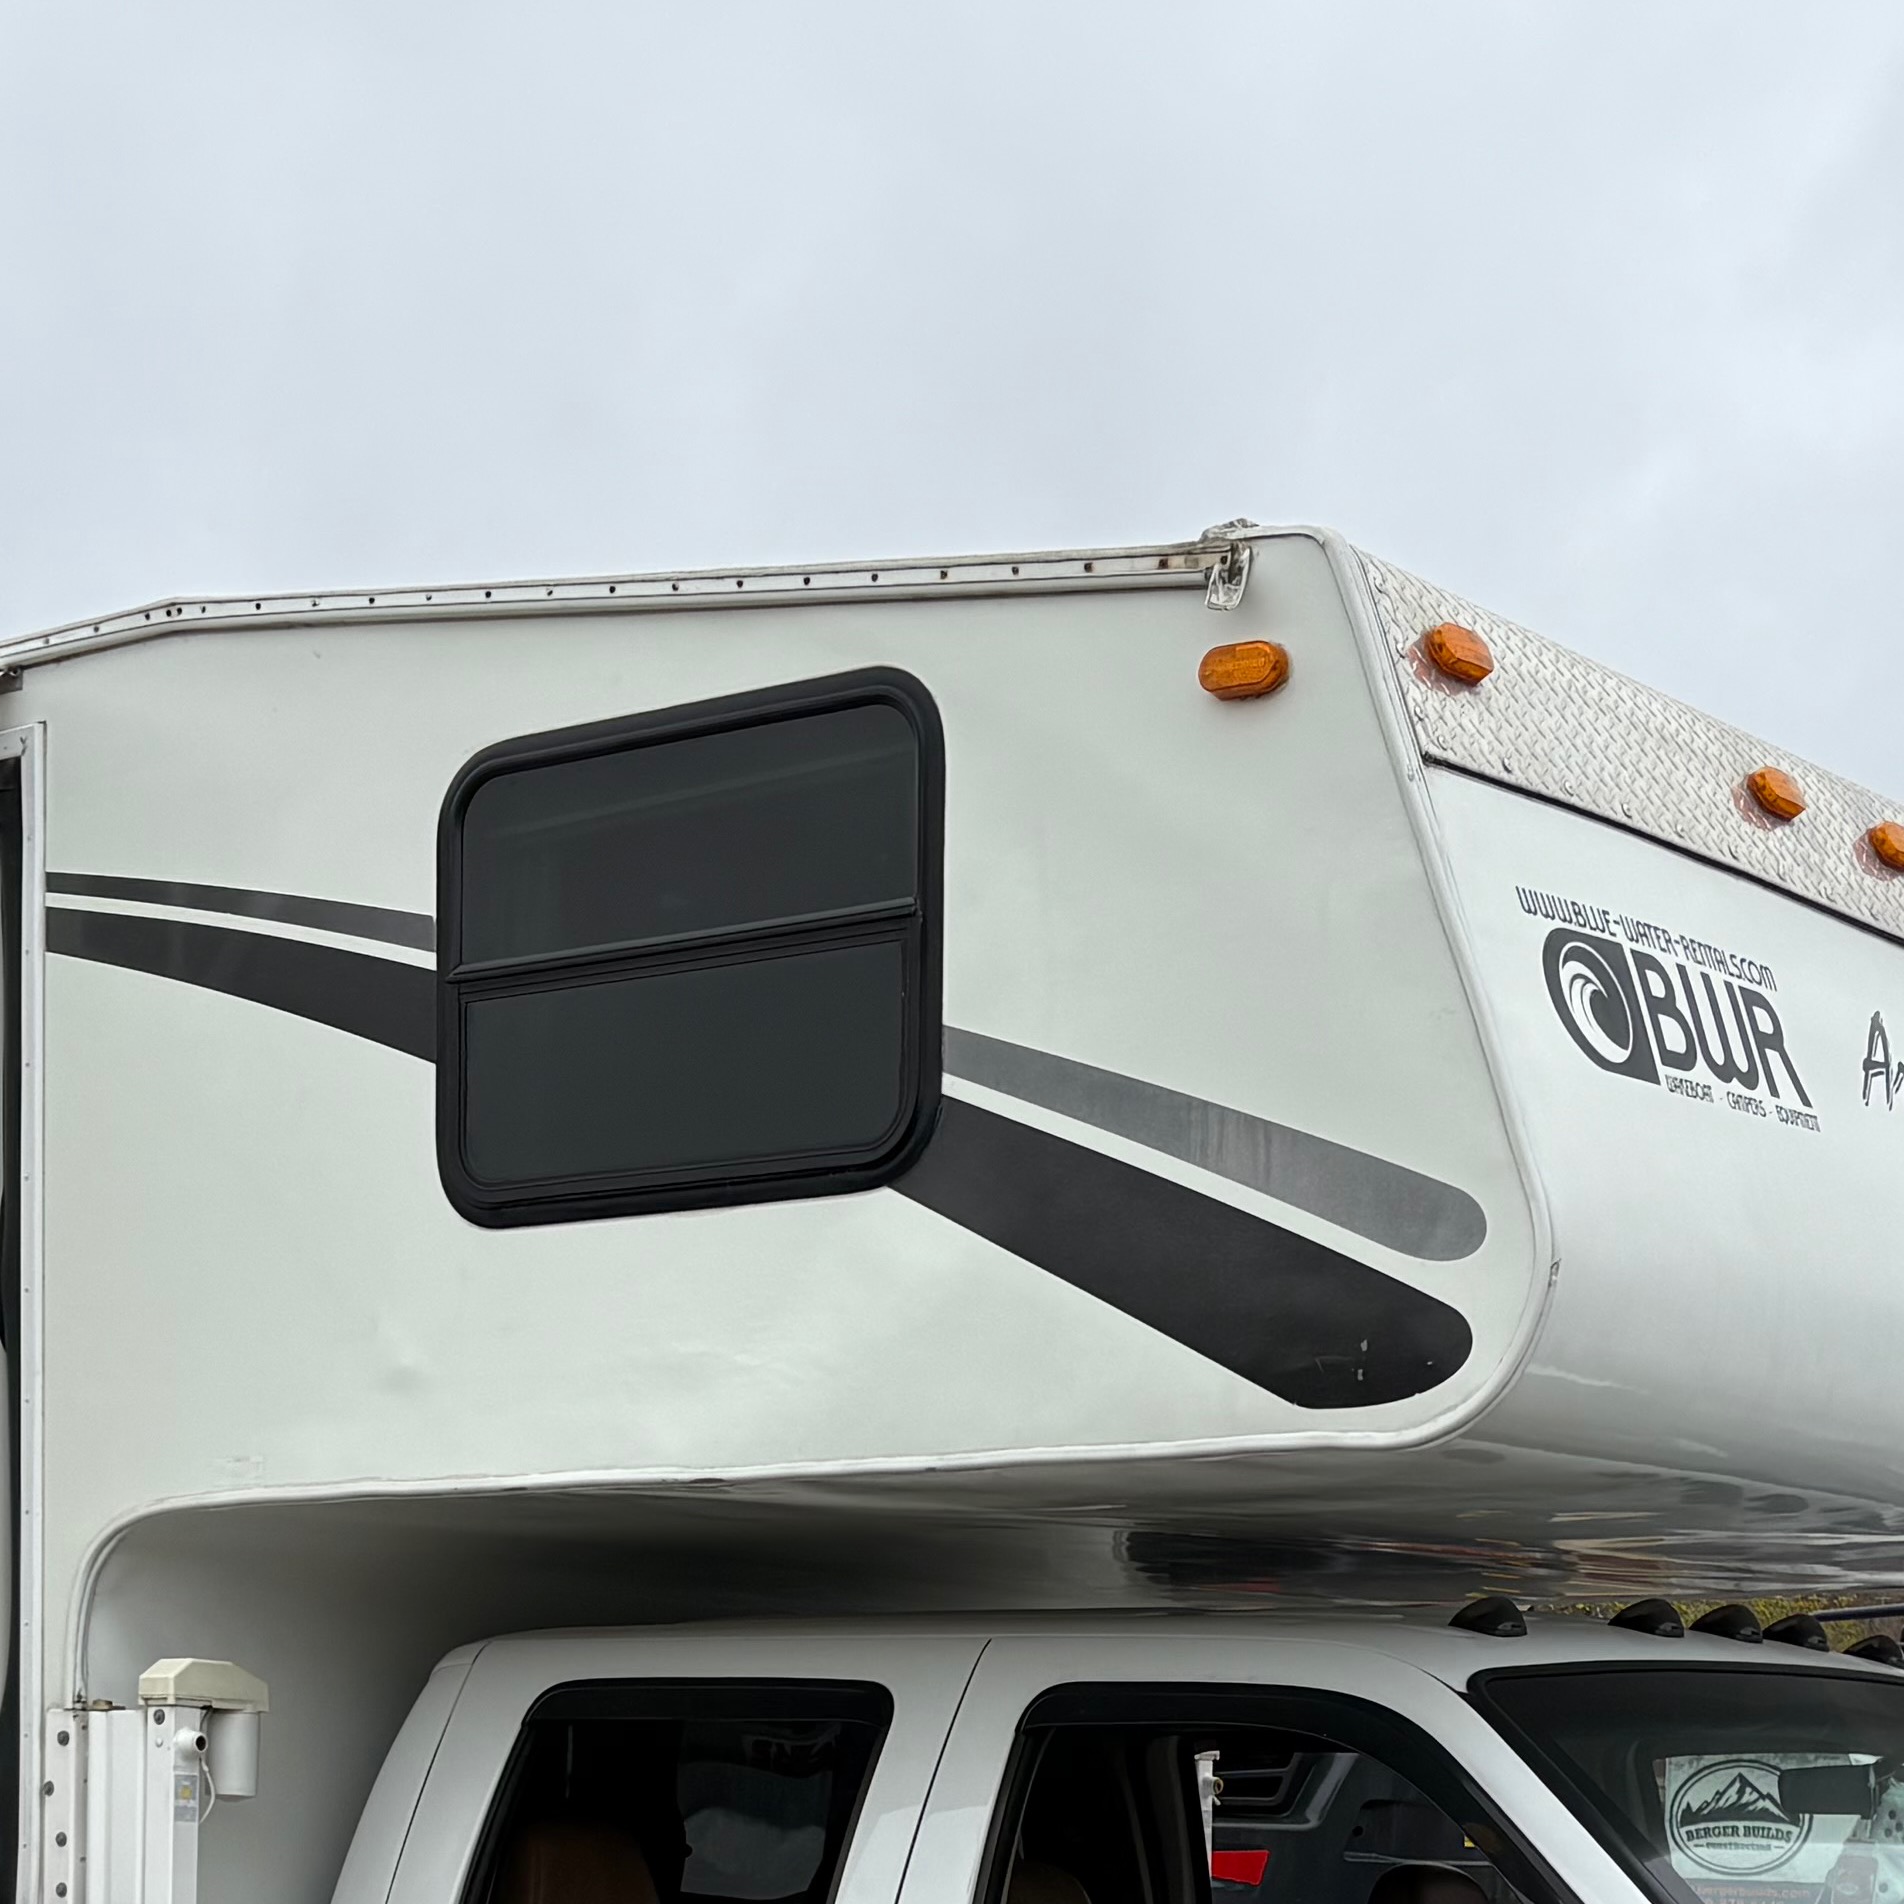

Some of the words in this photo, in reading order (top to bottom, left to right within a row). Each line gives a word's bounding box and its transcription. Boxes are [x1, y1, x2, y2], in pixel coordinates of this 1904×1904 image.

[1630, 947, 1814, 1109] BWR
[1685, 1826, 1740, 1842] BERGER
[1742, 1826, 1793, 1844] BUILDS
